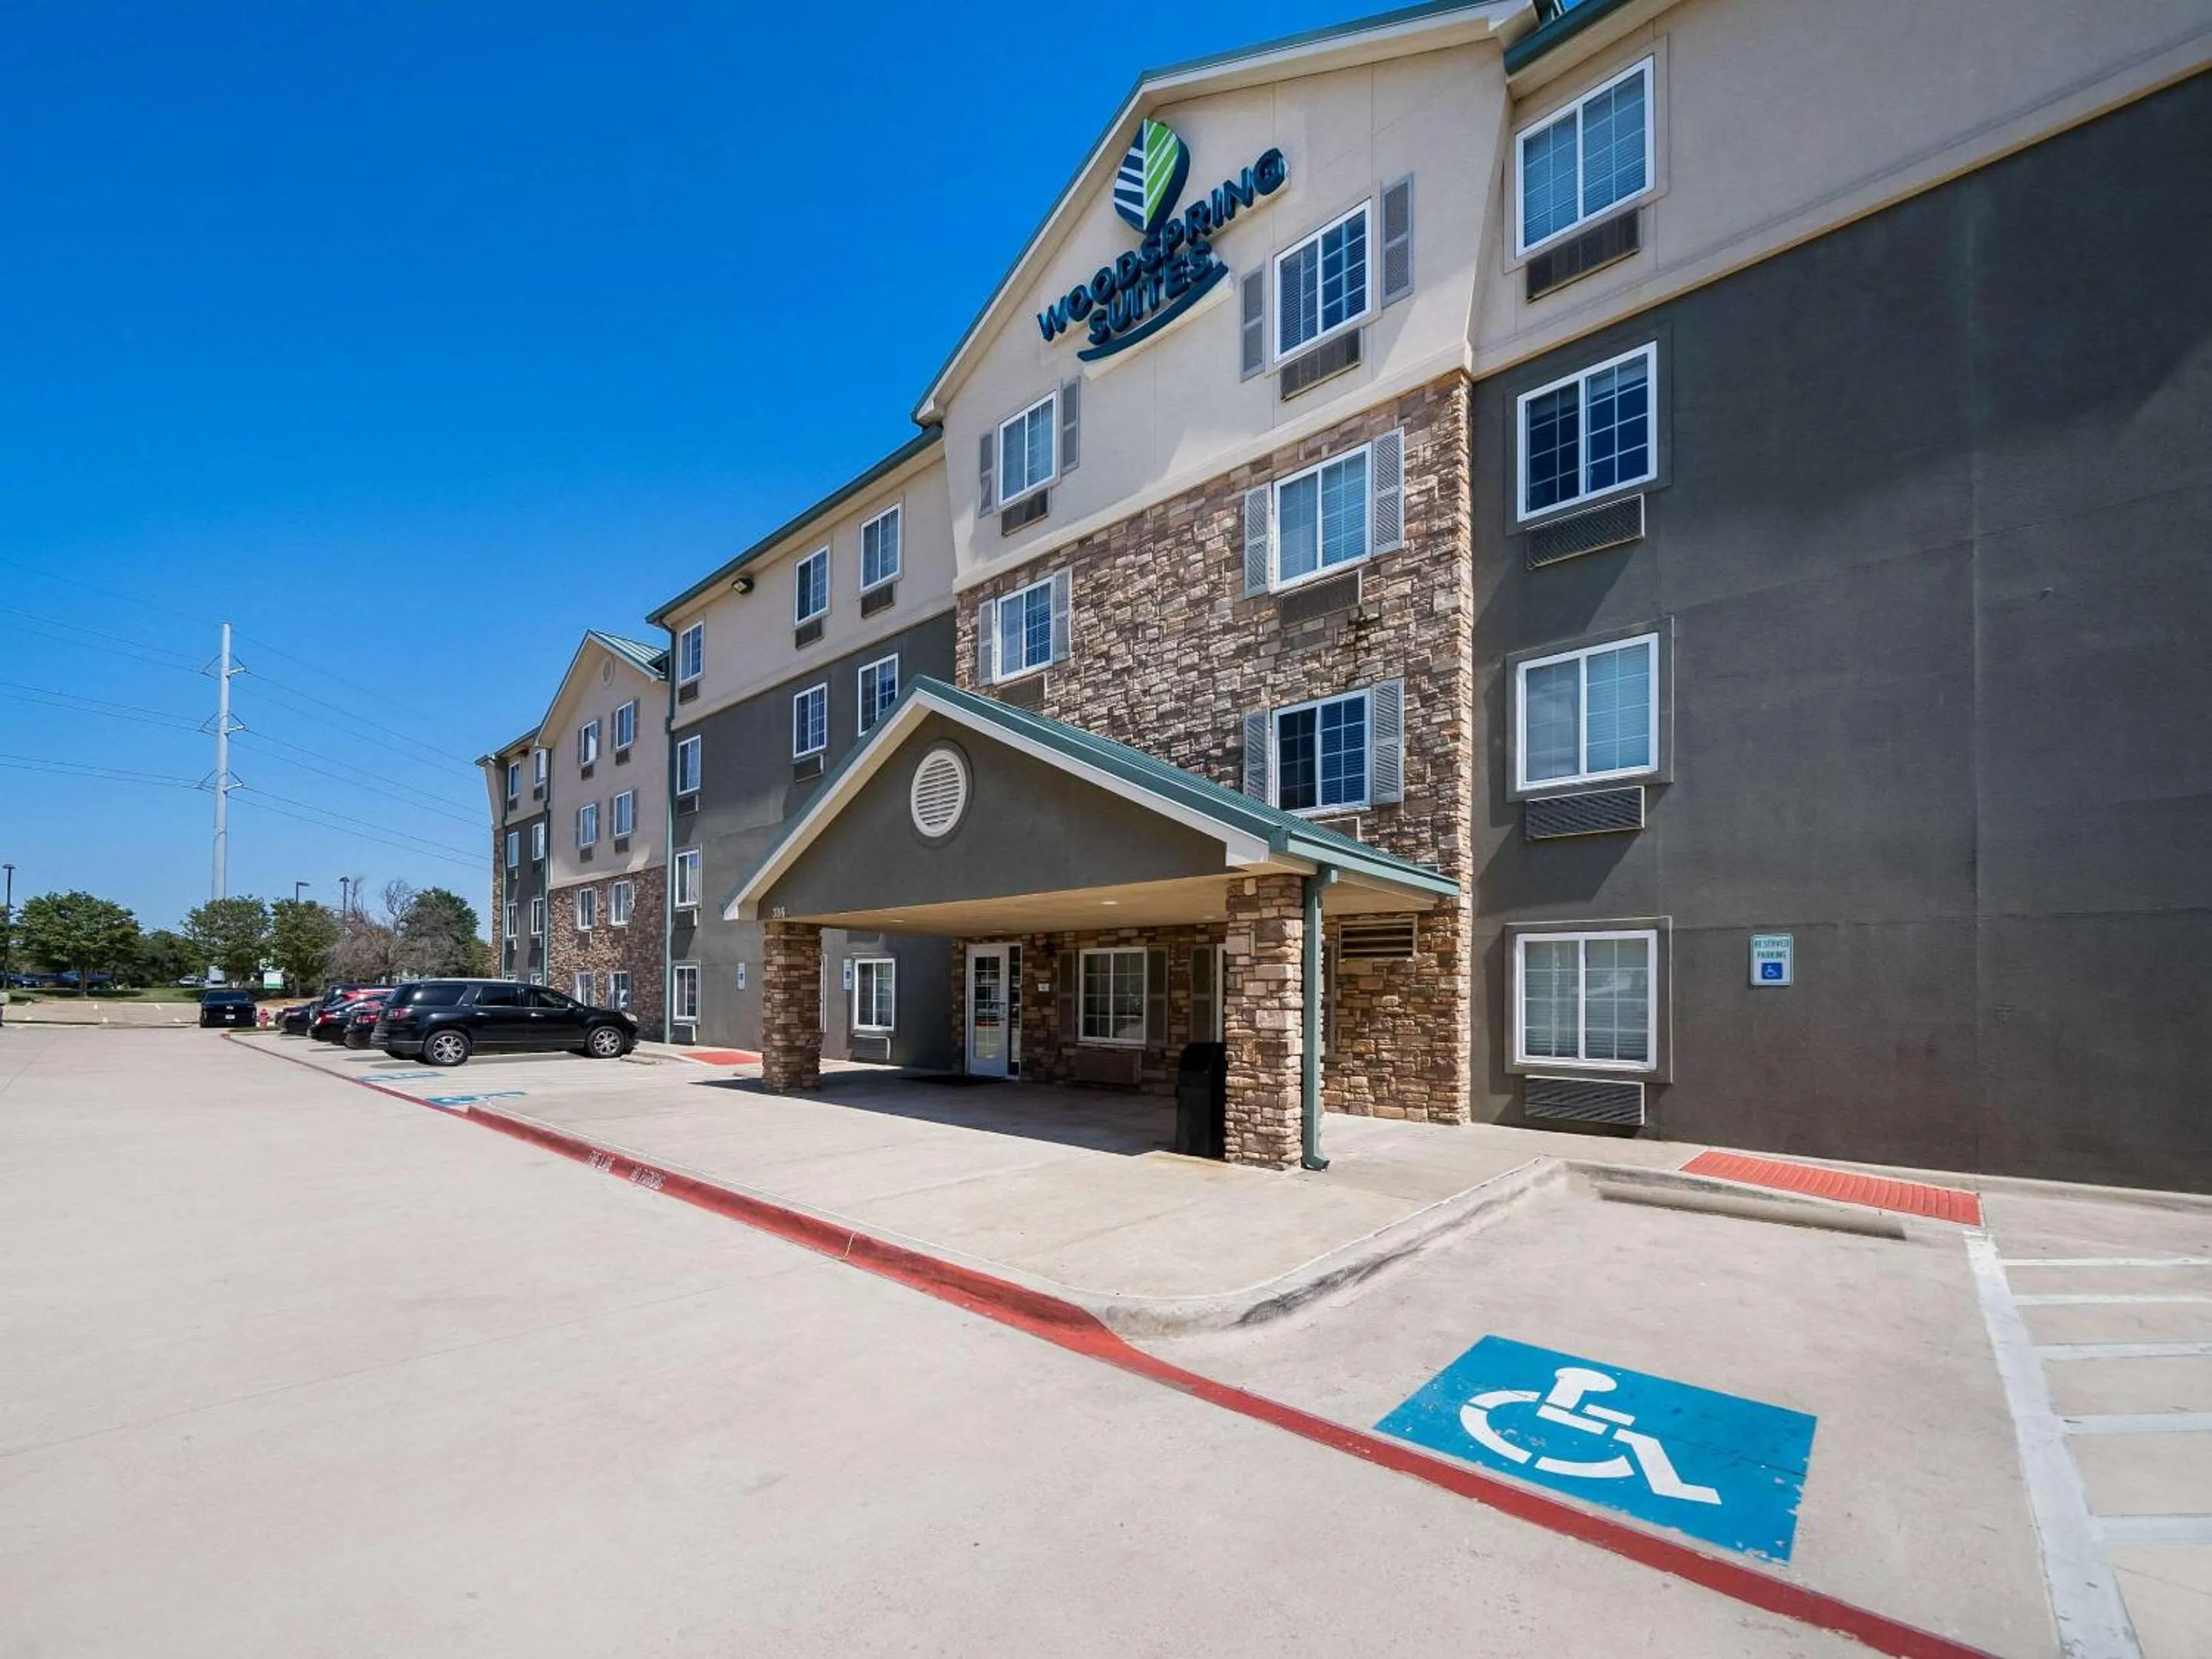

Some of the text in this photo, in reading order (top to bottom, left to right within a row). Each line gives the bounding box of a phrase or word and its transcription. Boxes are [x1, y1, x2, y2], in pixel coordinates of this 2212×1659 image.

[1037, 147, 1287, 343] WOODSPRING
[1088, 241, 1214, 346] SUITES
[1753, 939, 1790, 948] RESERVED
[1757, 951, 1787, 959] PARKING
